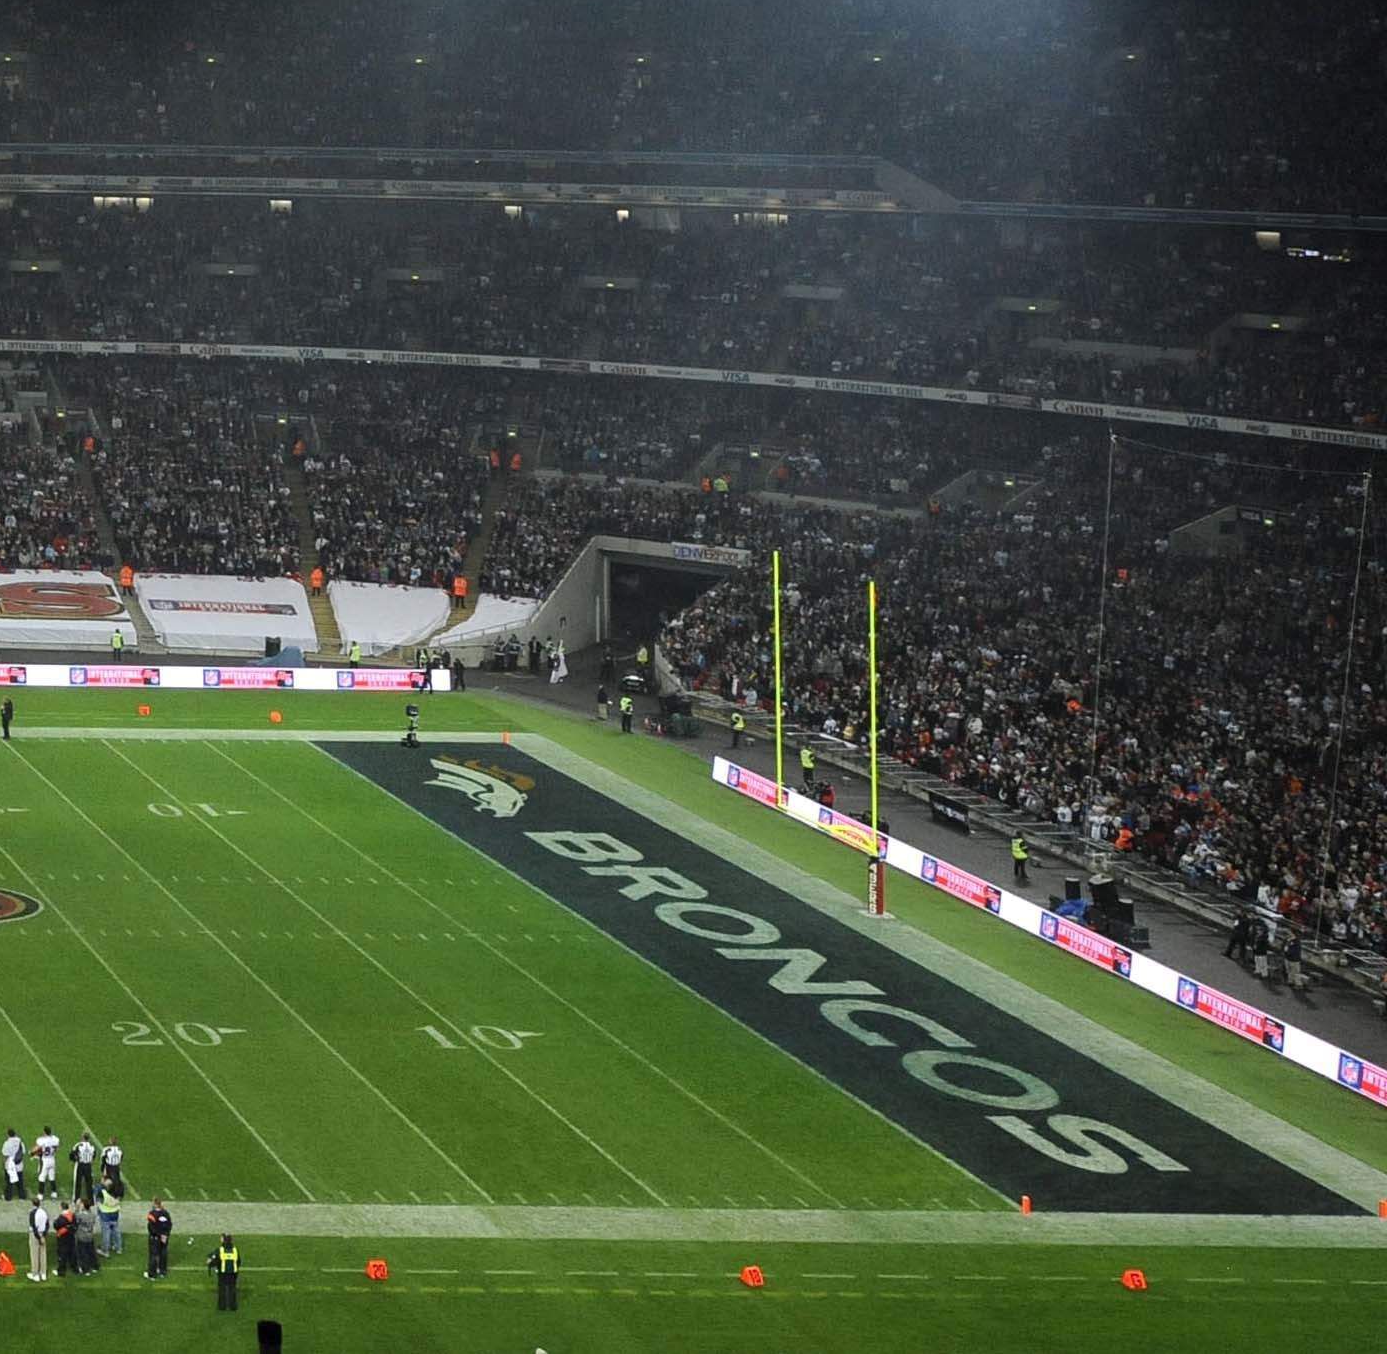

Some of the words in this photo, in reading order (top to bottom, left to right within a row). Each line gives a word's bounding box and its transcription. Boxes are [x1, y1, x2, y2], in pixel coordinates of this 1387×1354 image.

[298, 348, 324, 359] VISA
[722, 371, 751, 383] VISA
[1053, 400, 1104, 416] Canon
[1186, 414, 1218, 429] VISA
[1057, 925, 1113, 956] INTERNATIONAL
[523, 830, 1191, 1175] BRONCOS
[1197, 988, 1263, 1028] INTERNATIONAL
[1212, 1008, 1247, 1032] SERIES
[110, 1020, 226, 1047] 20
[416, 1024, 523, 1051] 10
